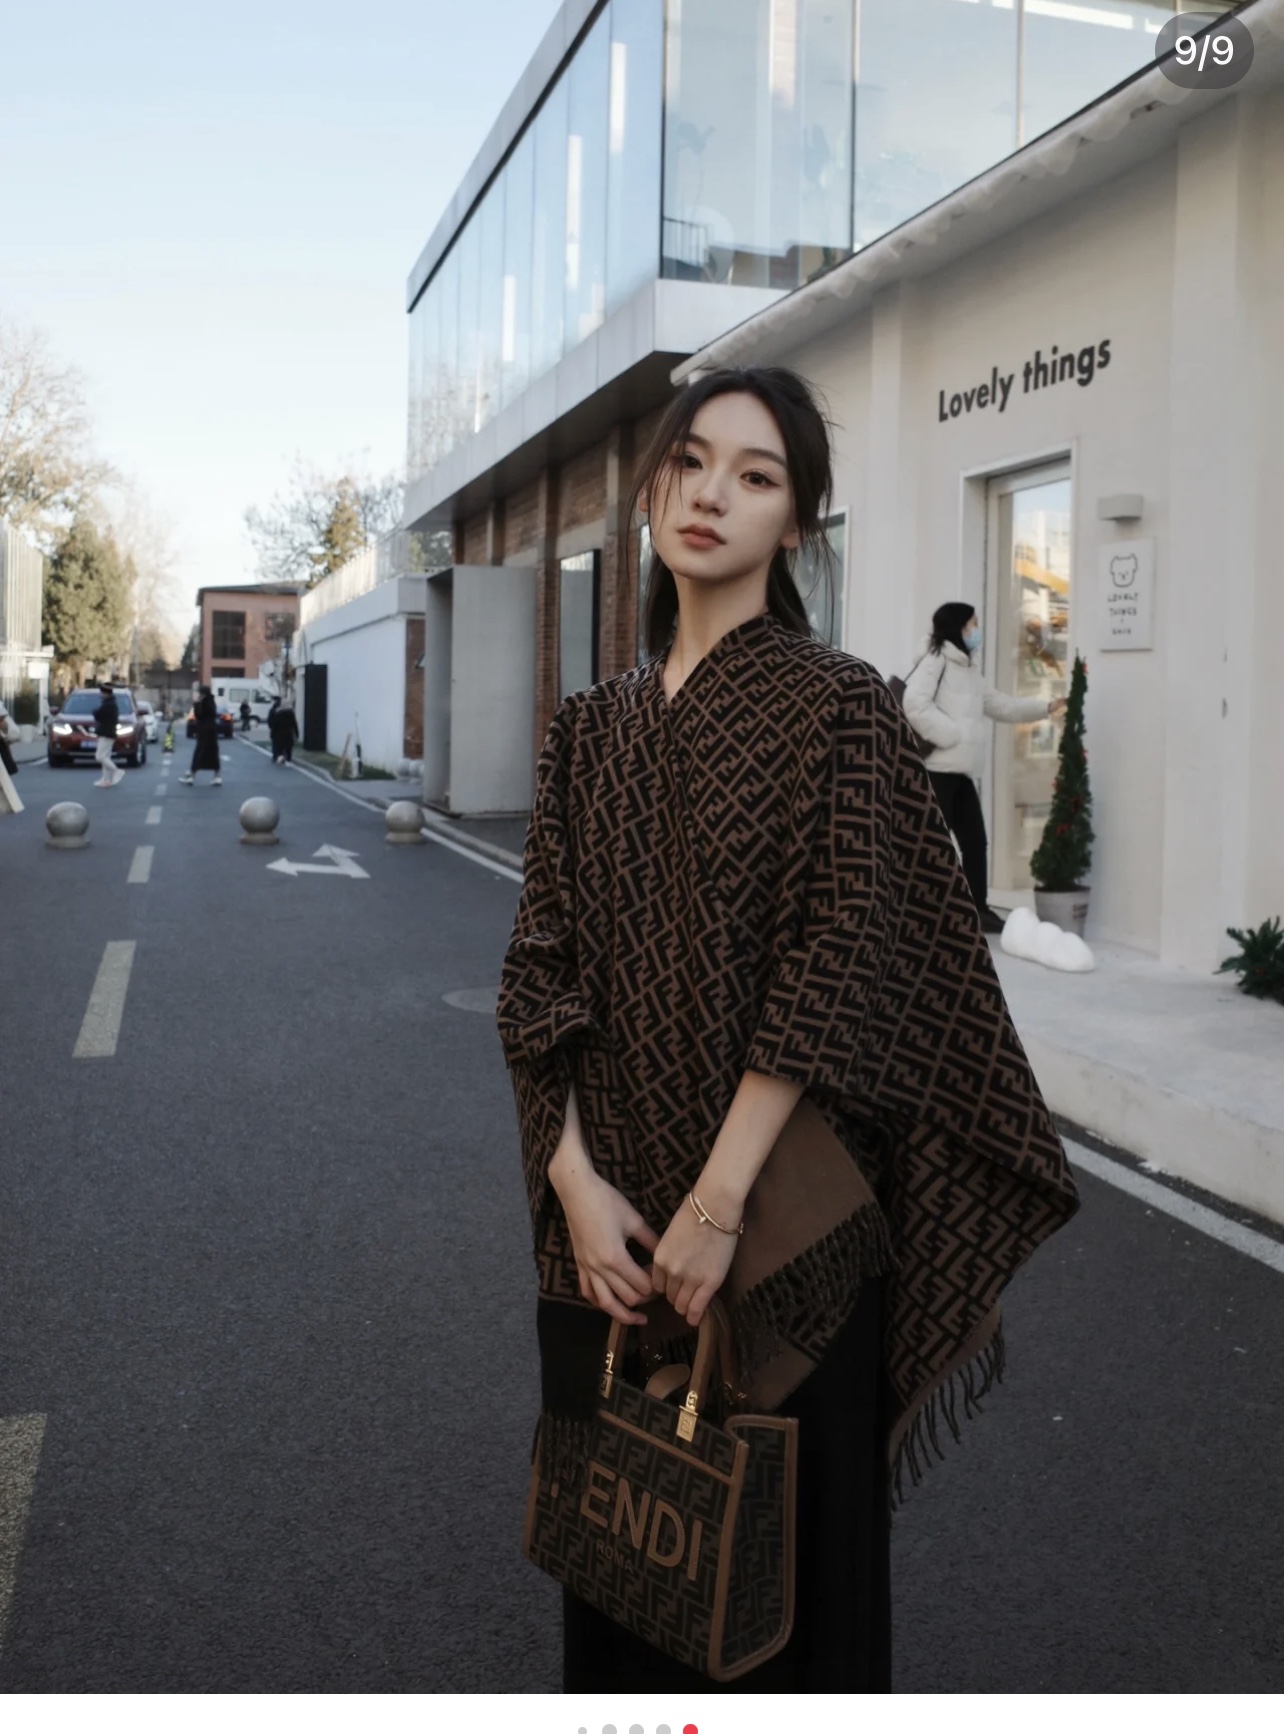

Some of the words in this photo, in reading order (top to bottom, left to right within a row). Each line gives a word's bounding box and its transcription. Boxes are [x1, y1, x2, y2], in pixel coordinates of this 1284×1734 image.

[939, 366, 1015, 423] Lovely
[1023, 339, 1111, 394] things
[551, 1460, 702, 1581] ENDI
[596, 1539, 634, 1575] ROMA
